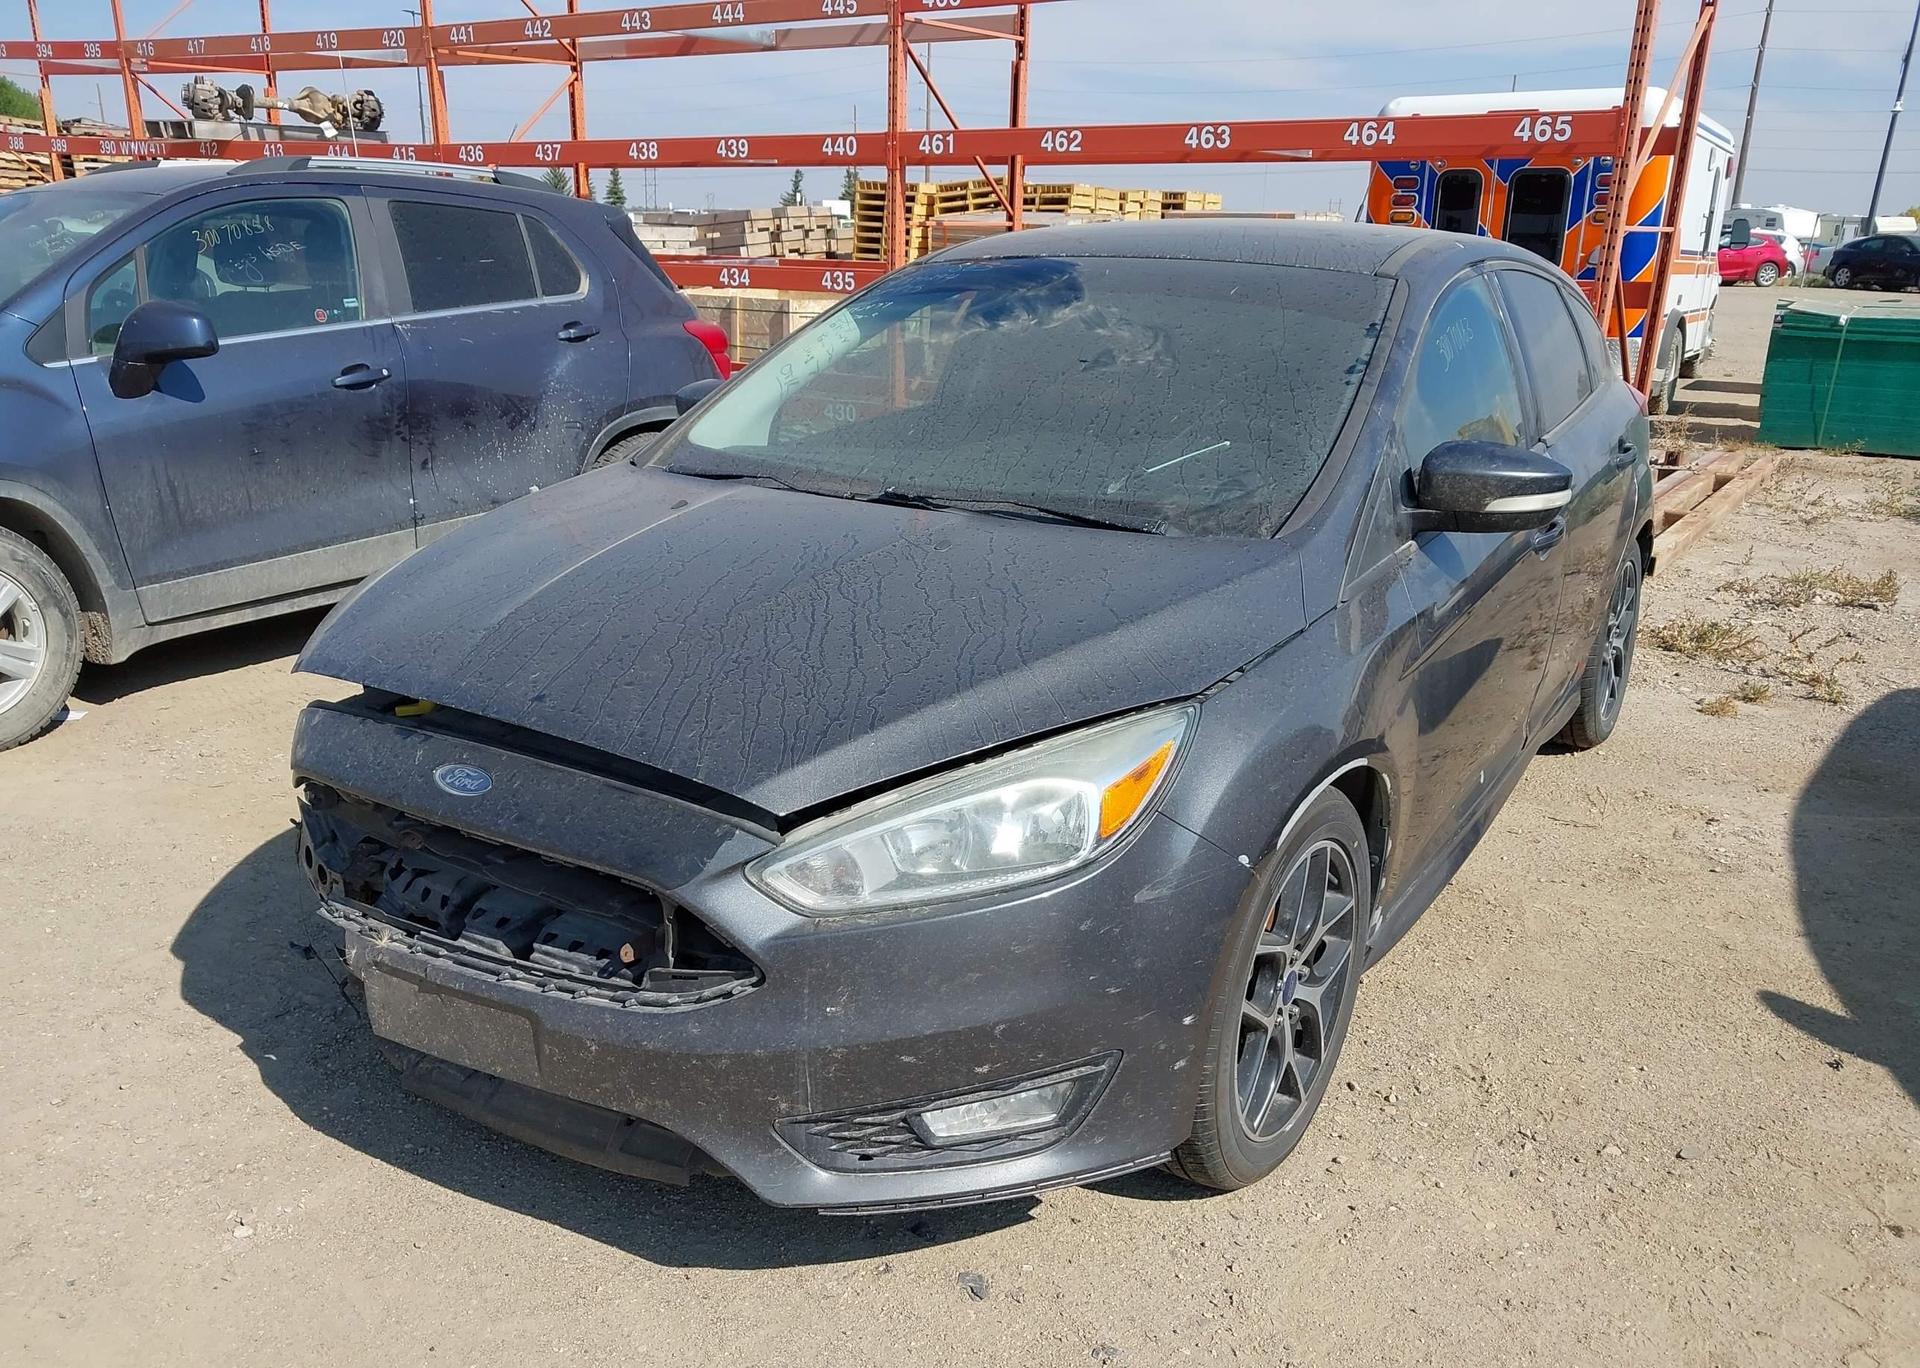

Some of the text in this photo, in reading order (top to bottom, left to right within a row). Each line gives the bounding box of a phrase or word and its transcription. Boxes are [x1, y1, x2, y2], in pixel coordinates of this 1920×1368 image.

[450, 0, 858, 43] 441 442 443 444 445
[36, 43, 53, 58] 394
[84, 43, 101, 58] 395
[136, 29, 405, 57] 416 417 418 419 420
[8, 137, 24, 150] 388
[51, 138, 67, 152] 389
[99, 140, 116, 155] 390
[918, 116, 1572, 155] 461 462 463 464 465
[199, 142, 218, 157] 412
[264, 143, 283, 157] 413
[328, 145, 348, 157] 414
[392, 147, 415, 161] 415
[459, 137, 856, 162] 436 437 438 439 440
[719, 268, 855, 291] 434 435
[824, 404, 855, 422] 430
[446, 768, 483, 789] Ford
